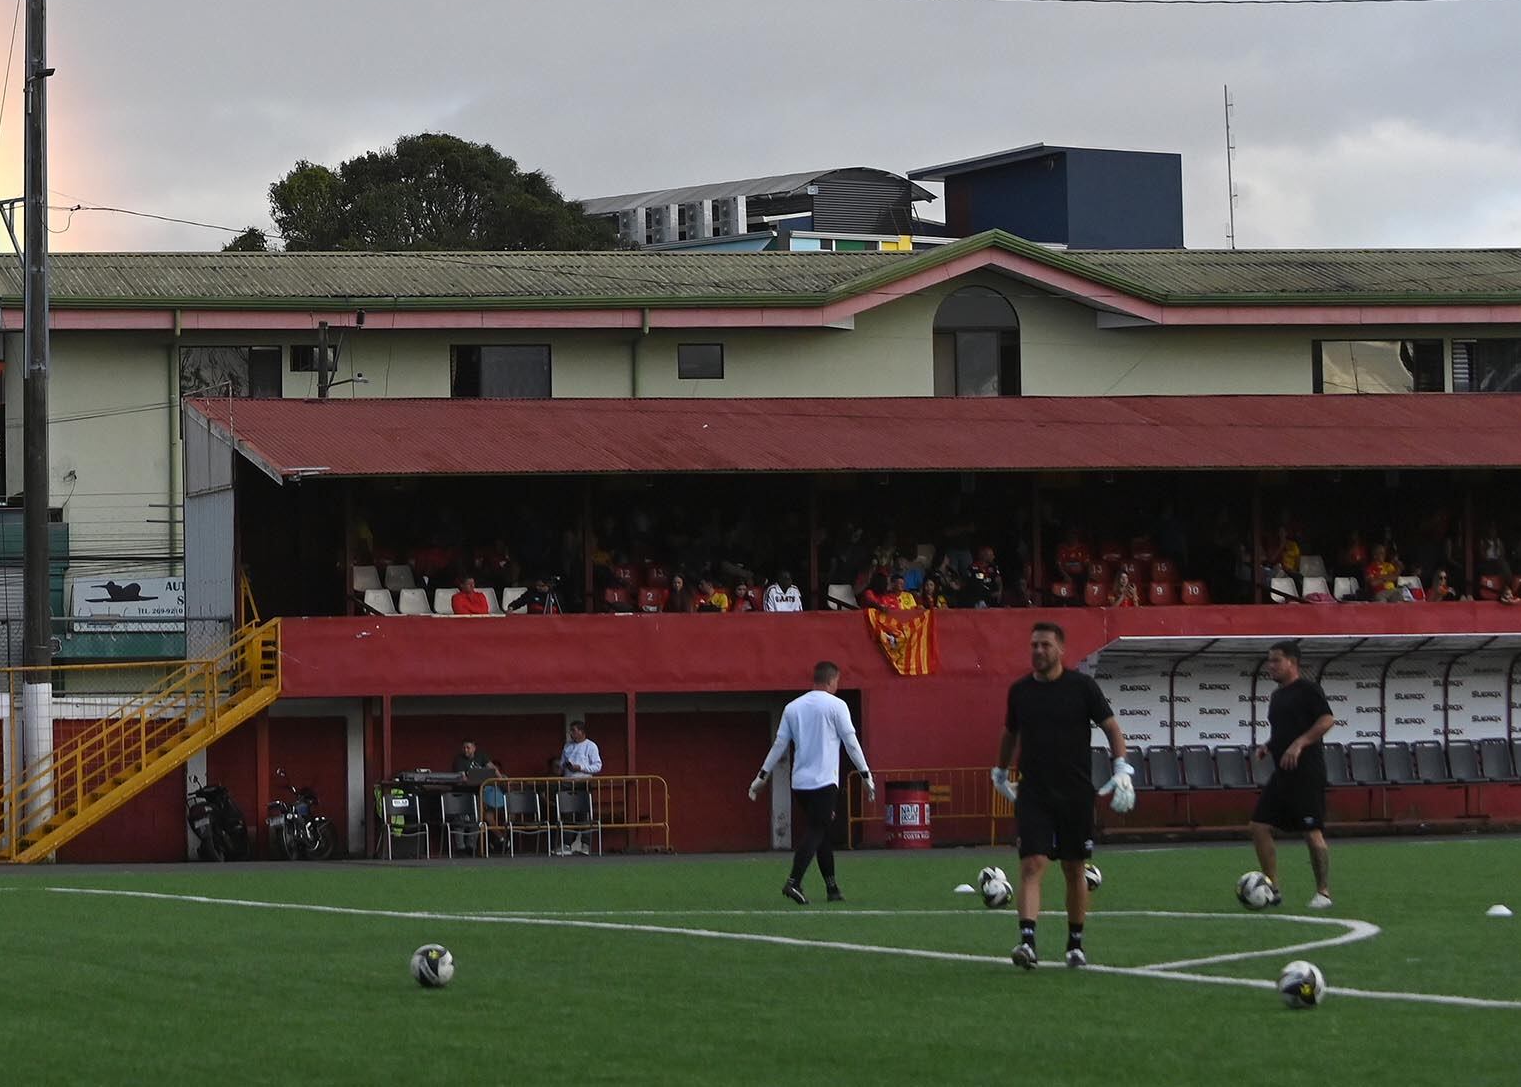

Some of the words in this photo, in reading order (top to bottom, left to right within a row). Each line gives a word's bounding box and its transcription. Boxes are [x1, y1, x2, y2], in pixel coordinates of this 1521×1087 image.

[1092, 586, 1099, 595] 7
[1156, 586, 1163, 595] 9
[1188, 586, 1199, 595] 10
[646, 592, 653, 601] 2
